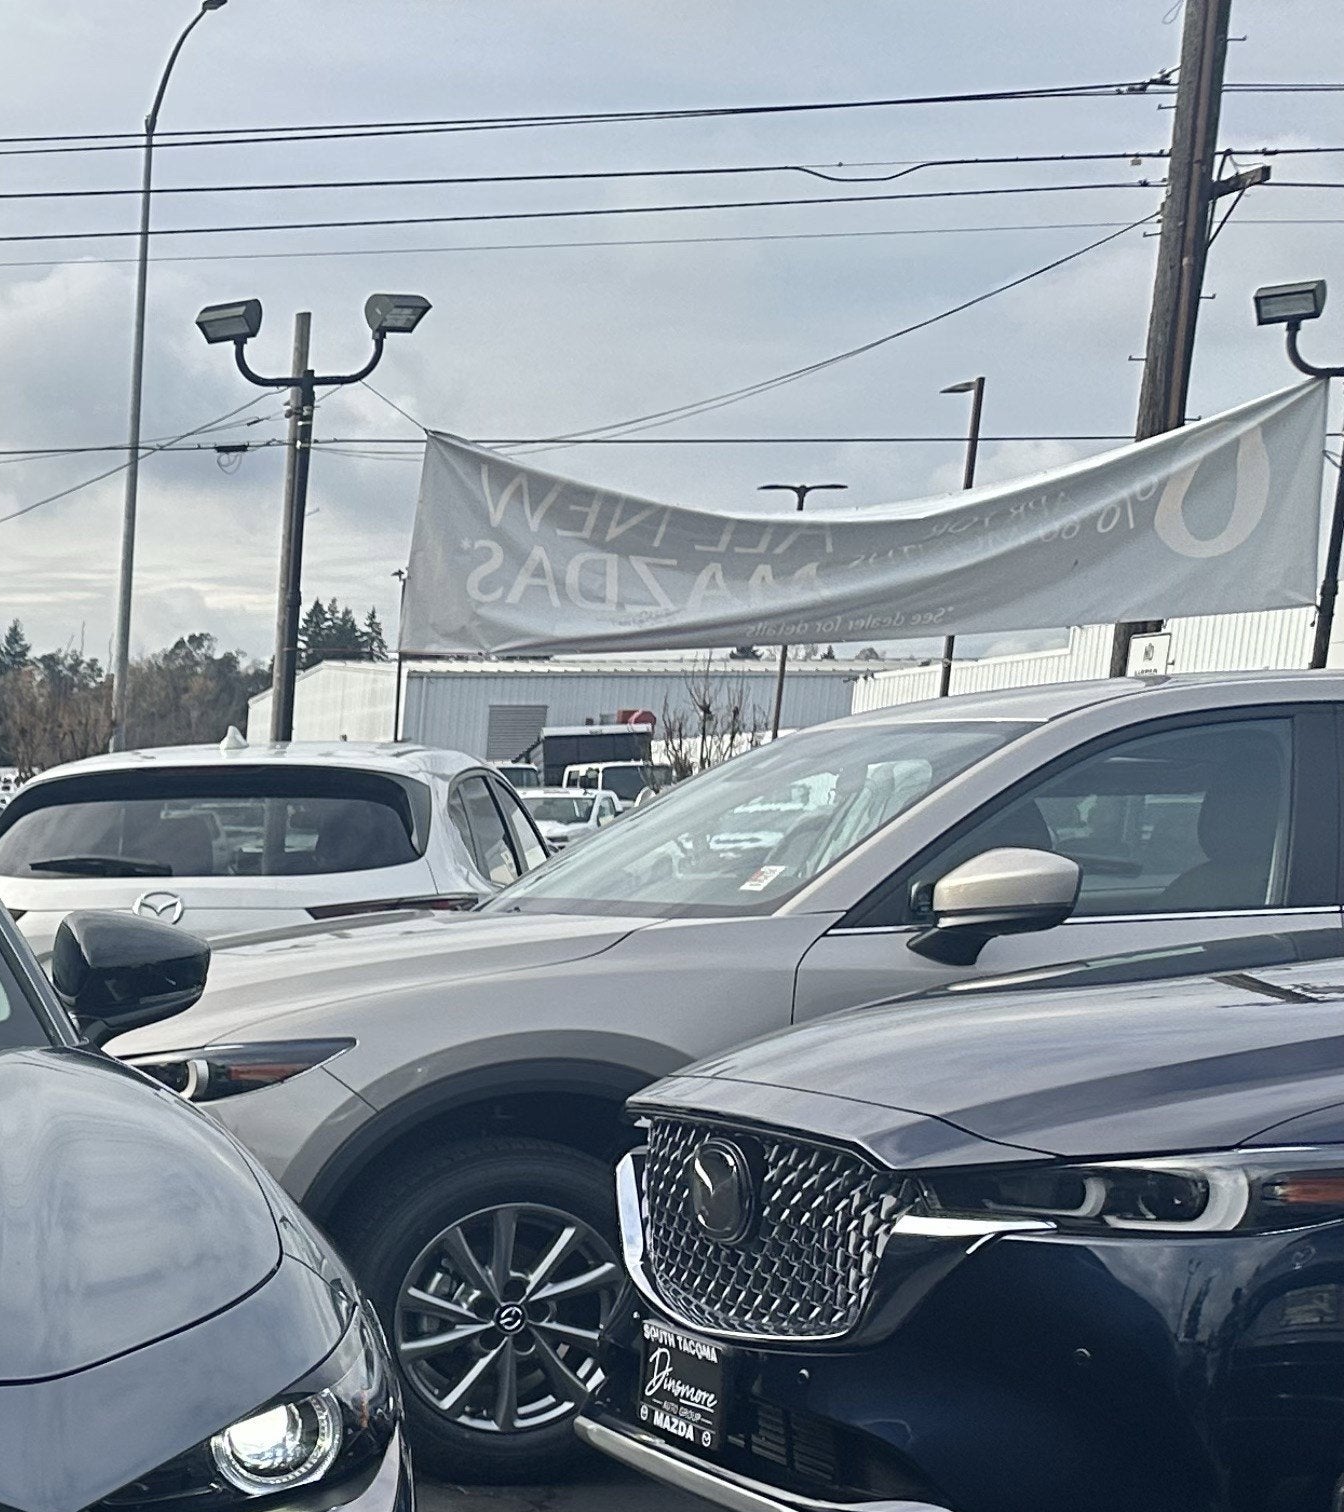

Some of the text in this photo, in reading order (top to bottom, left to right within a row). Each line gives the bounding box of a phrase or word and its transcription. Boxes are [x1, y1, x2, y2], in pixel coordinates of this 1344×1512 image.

[643, 1323, 719, 1364] SOUTH TACOMA
[644, 1347, 718, 1408] Dinsmore
[653, 1410, 695, 1442] MAZDA
